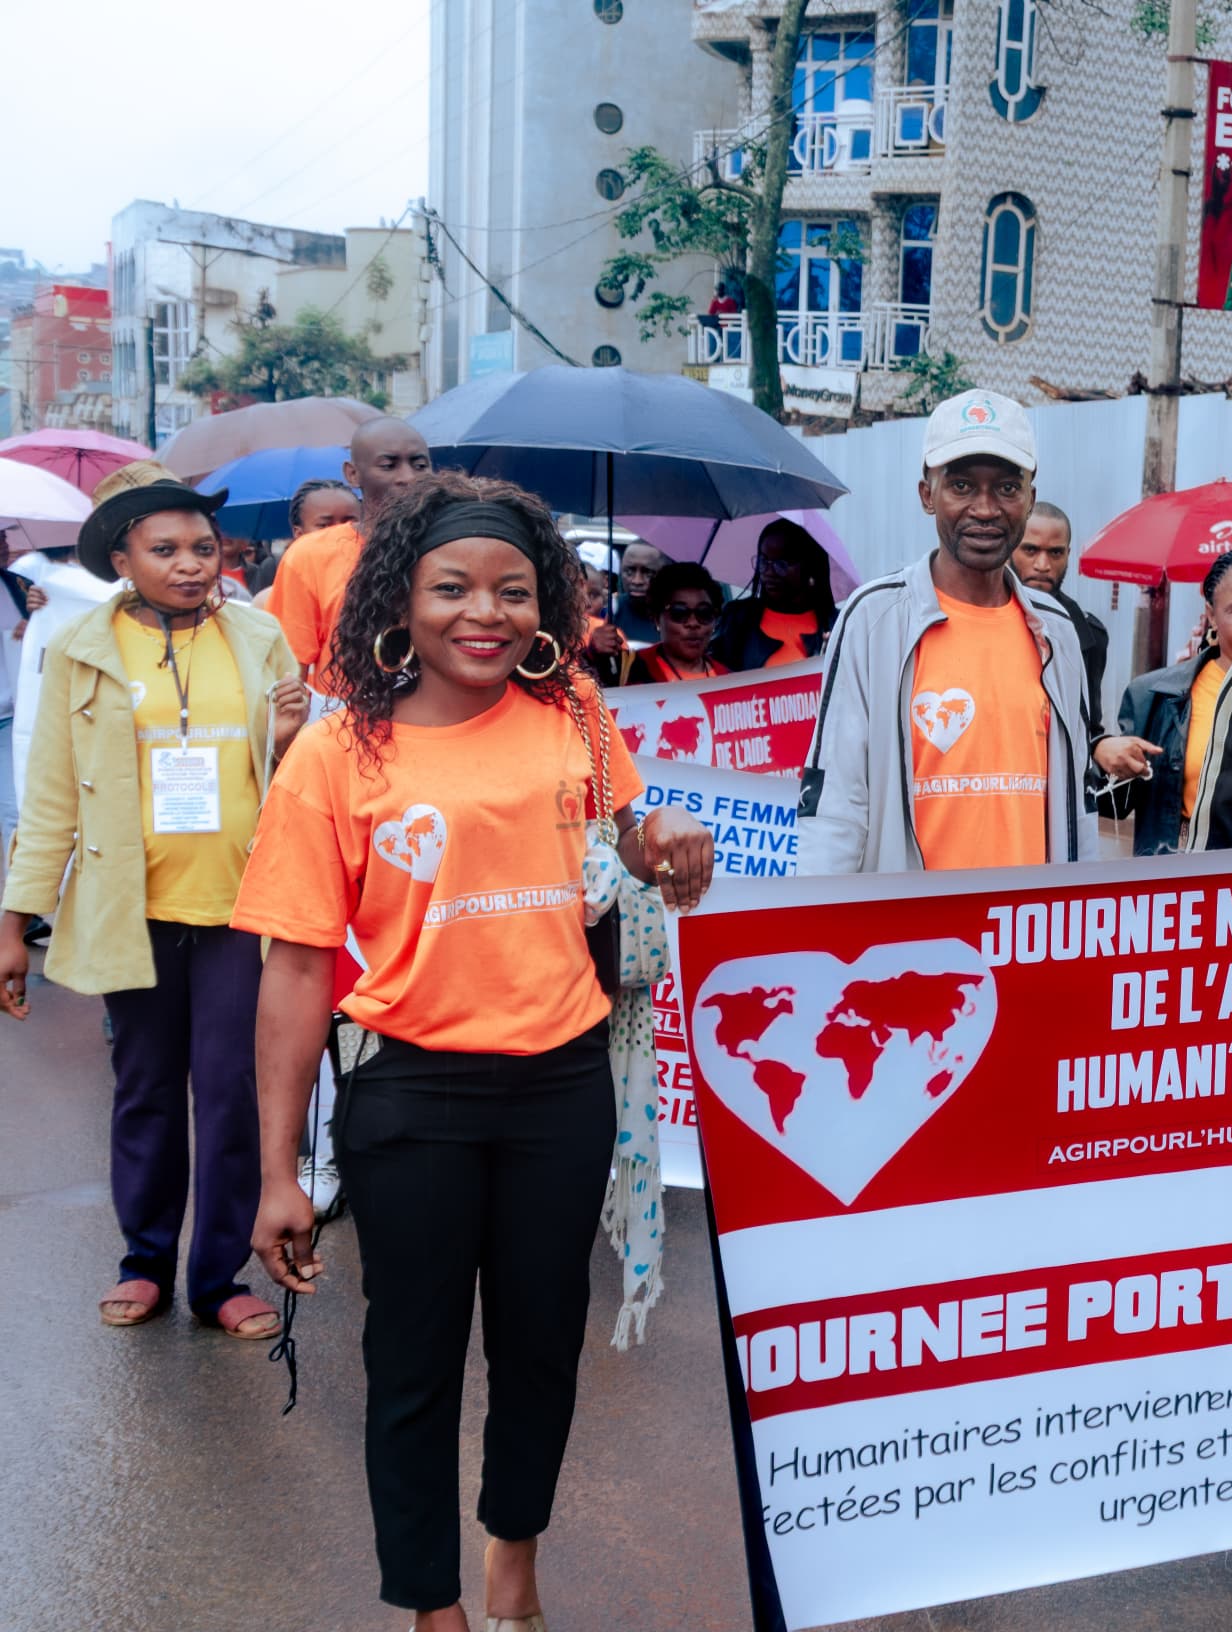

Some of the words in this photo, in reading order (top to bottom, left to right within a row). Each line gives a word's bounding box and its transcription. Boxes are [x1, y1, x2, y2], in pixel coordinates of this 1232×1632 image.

[713, 693, 768, 735] JOURNÉE
[715, 741, 734, 769] DE
[734, 735, 772, 769] L'AIDE
[645, 785, 704, 813] DES
[981, 890, 1204, 968] JOURNEE
[1111, 968, 1170, 1031] DE
[769, 1415, 1023, 1488] Humanitaires
[913, 1475, 976, 1520] par
[988, 1463, 1037, 1496] les
[1049, 1437, 1186, 1485] conflits
